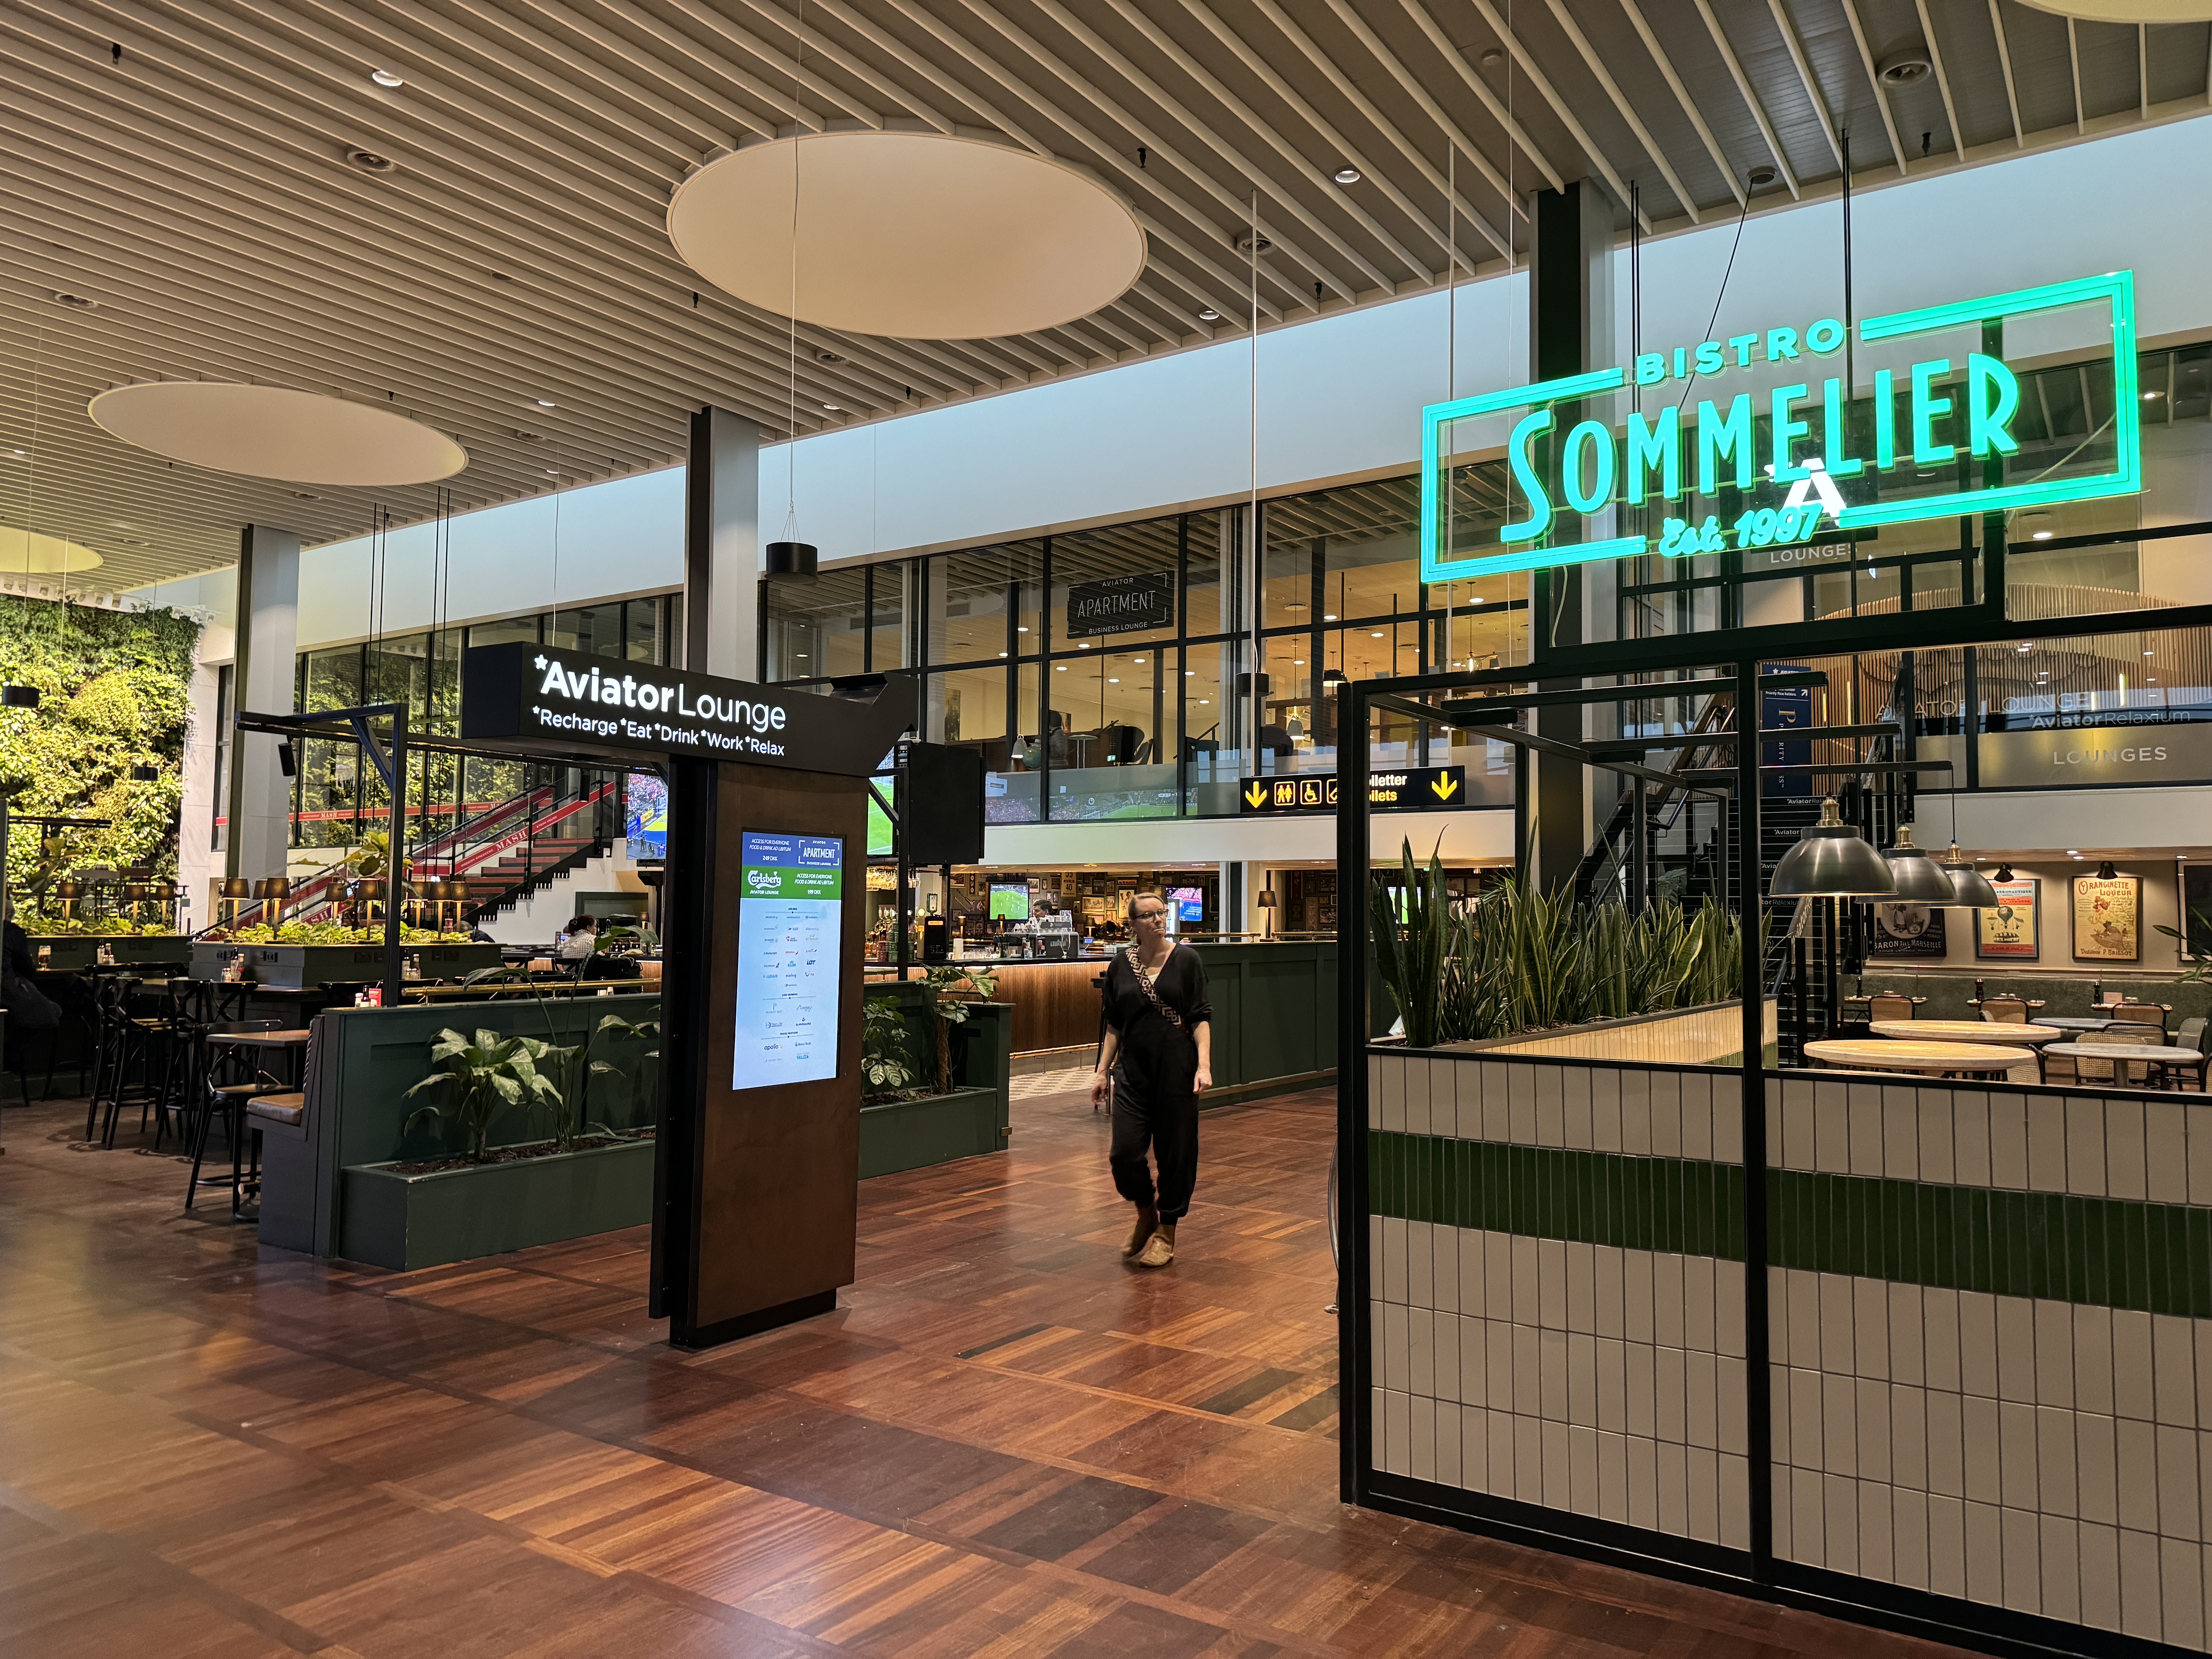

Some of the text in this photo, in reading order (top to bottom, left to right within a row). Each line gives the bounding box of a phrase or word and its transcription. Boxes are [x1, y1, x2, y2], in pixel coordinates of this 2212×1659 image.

[1635, 318, 1848, 386] BISTRO
[1500, 352, 2019, 544] SOMMELIER
[1659, 503, 1823, 557] Est. 1997
[1770, 542, 1858, 564] LOUNGES
[1102, 577, 1133, 587] AVIATOR
[1078, 590, 1156, 618] APARTMENT
[1089, 622, 1147, 634] BUSINESS LOUNGE
[1989, 692, 2089, 713] LOUNGE
[540, 709, 785, 756] Recharge Eat Drink Work Relax
[2054, 747, 2167, 765] LOUNGES
[1369, 775, 1407, 787] iletter
[1369, 790, 1397, 802] ilets
[495, 830, 527, 851] MASH
[803, 847, 835, 859] APARTMENT
[747, 870, 781, 887] Carlsberg
[2078, 881, 2129, 895] ORANGINETTE
[1875, 940, 1899, 949] BARON
[1911, 940, 1941, 948] MARSEILLE
